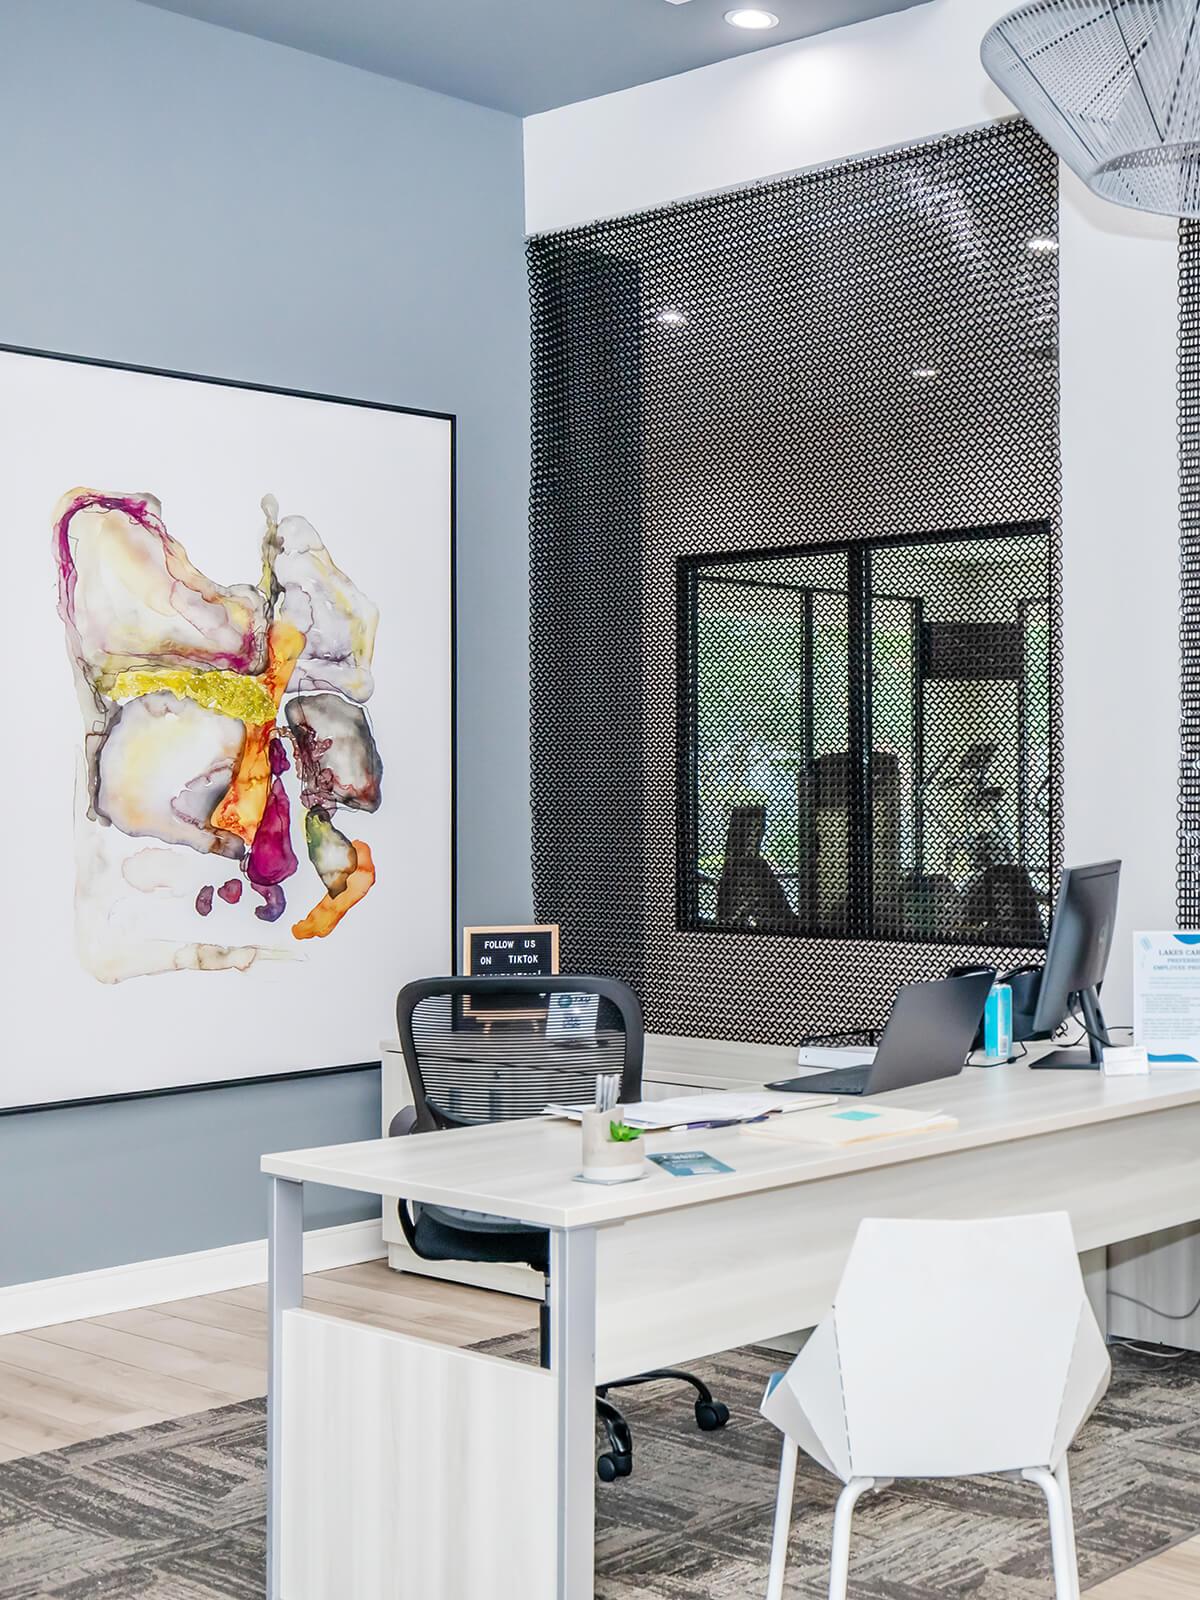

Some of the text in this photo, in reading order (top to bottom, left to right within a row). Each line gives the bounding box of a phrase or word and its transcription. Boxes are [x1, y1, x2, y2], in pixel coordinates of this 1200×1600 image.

[484, 940, 536, 949] FOLLOW US
[480, 954, 539, 965] ON TIKTOK
